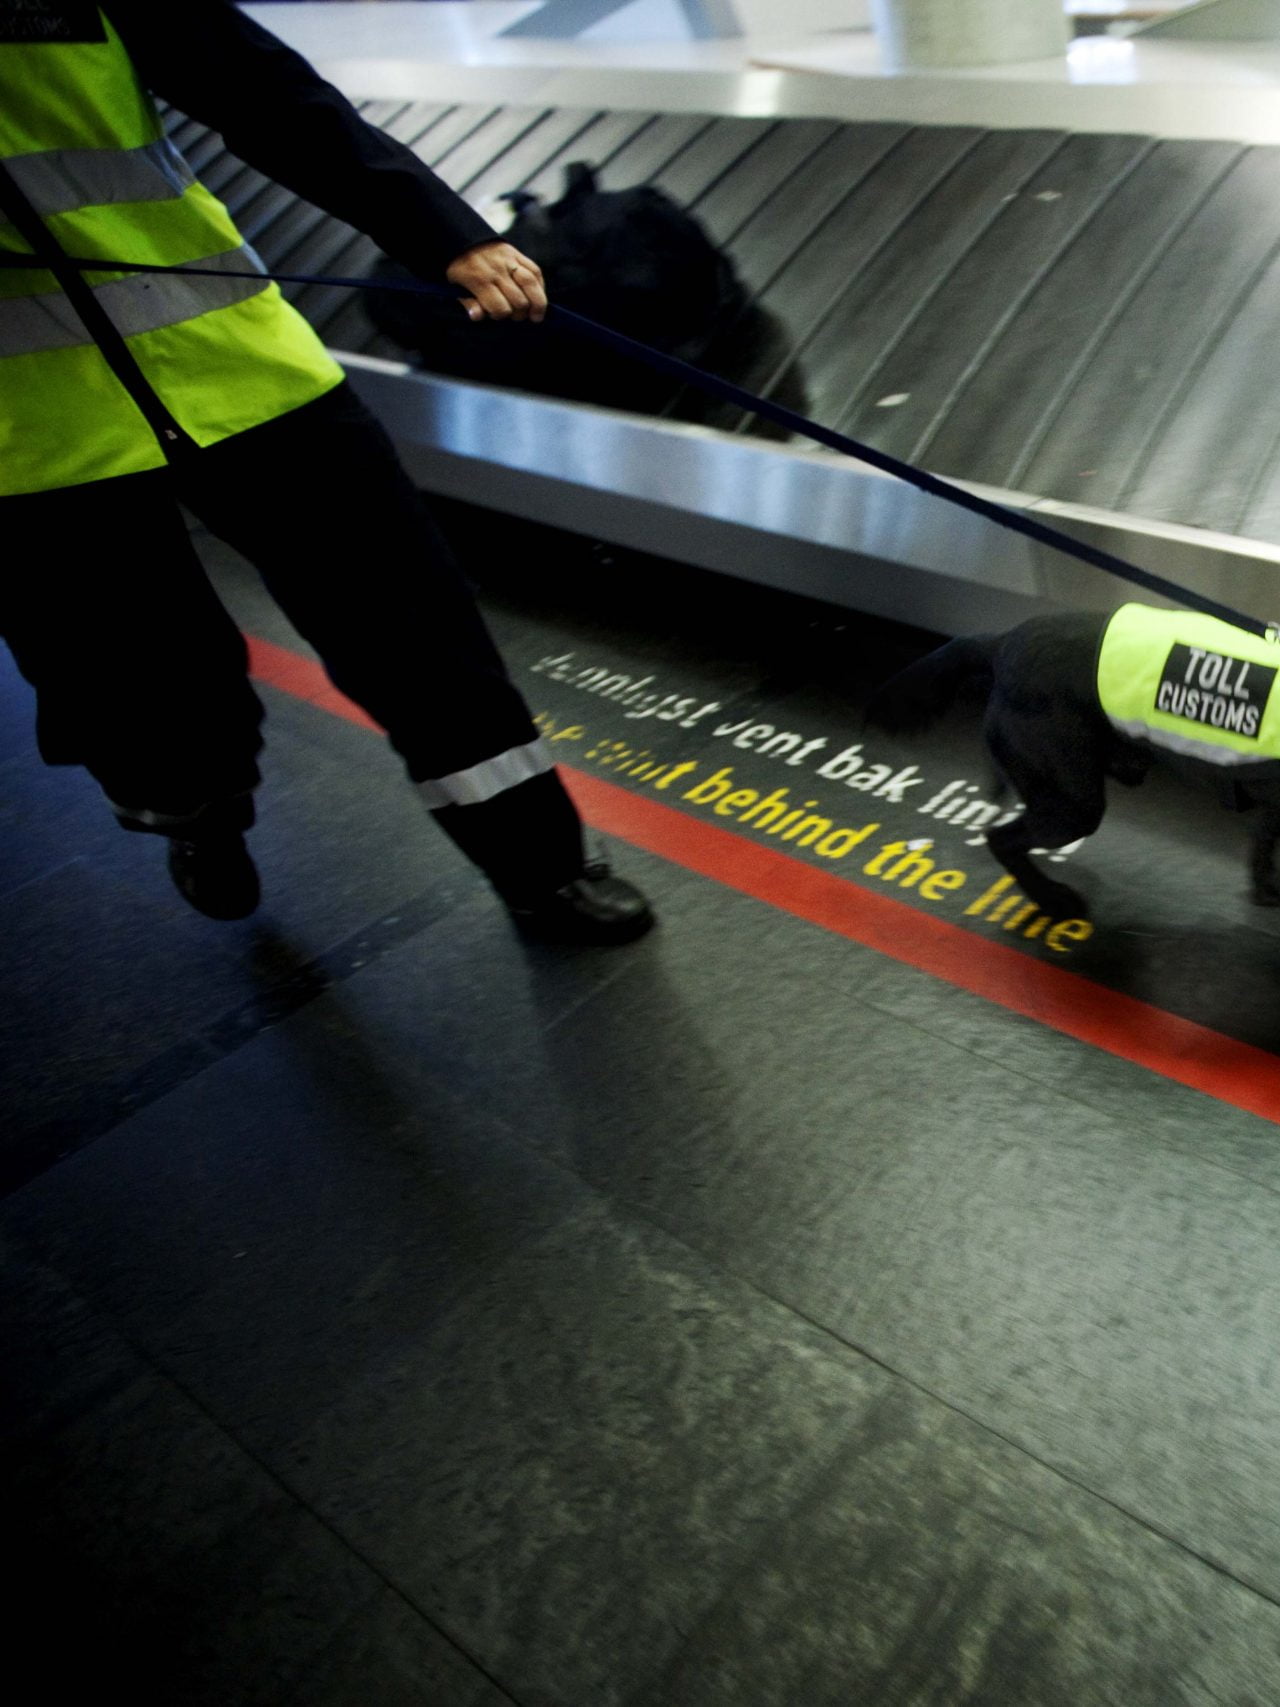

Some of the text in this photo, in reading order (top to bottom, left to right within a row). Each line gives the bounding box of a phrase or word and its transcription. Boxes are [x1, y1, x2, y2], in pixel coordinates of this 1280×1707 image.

[1184, 646, 1250, 699] TOLL
[1158, 680, 1259, 736] CUSTOMS
[712, 718, 829, 766] vent
[815, 744, 925, 803] bak
[682, 766, 881, 859] behind
[863, 839, 967, 900] the
